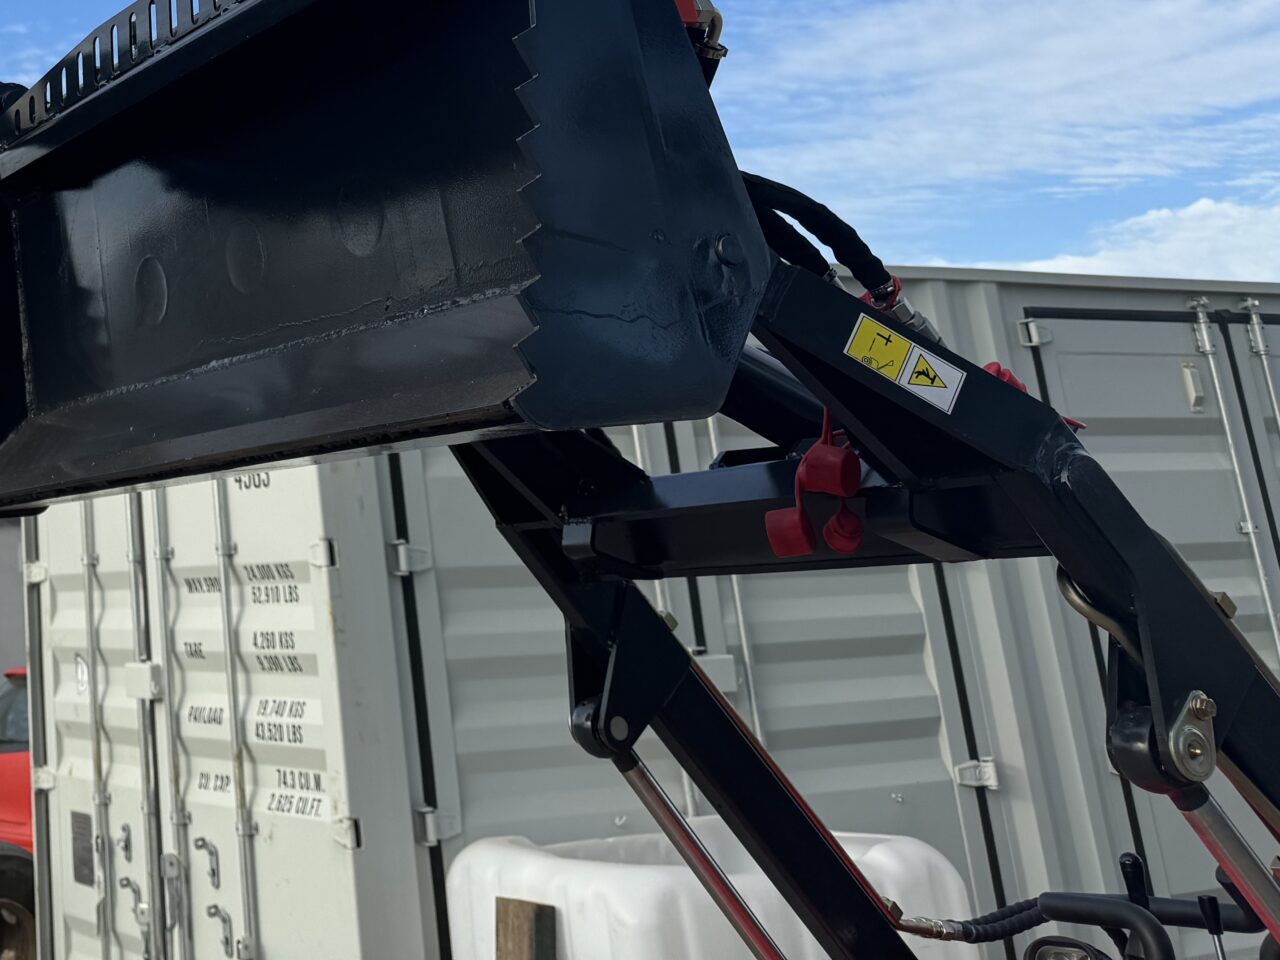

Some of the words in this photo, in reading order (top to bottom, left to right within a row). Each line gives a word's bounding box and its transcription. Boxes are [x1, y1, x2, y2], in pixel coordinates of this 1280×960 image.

[282, 584, 300, 603] LBS
[278, 631, 296, 650] KGS
[282, 654, 304, 673] LBS
[288, 701, 307, 719] KGS
[286, 724, 304, 744] LBS
